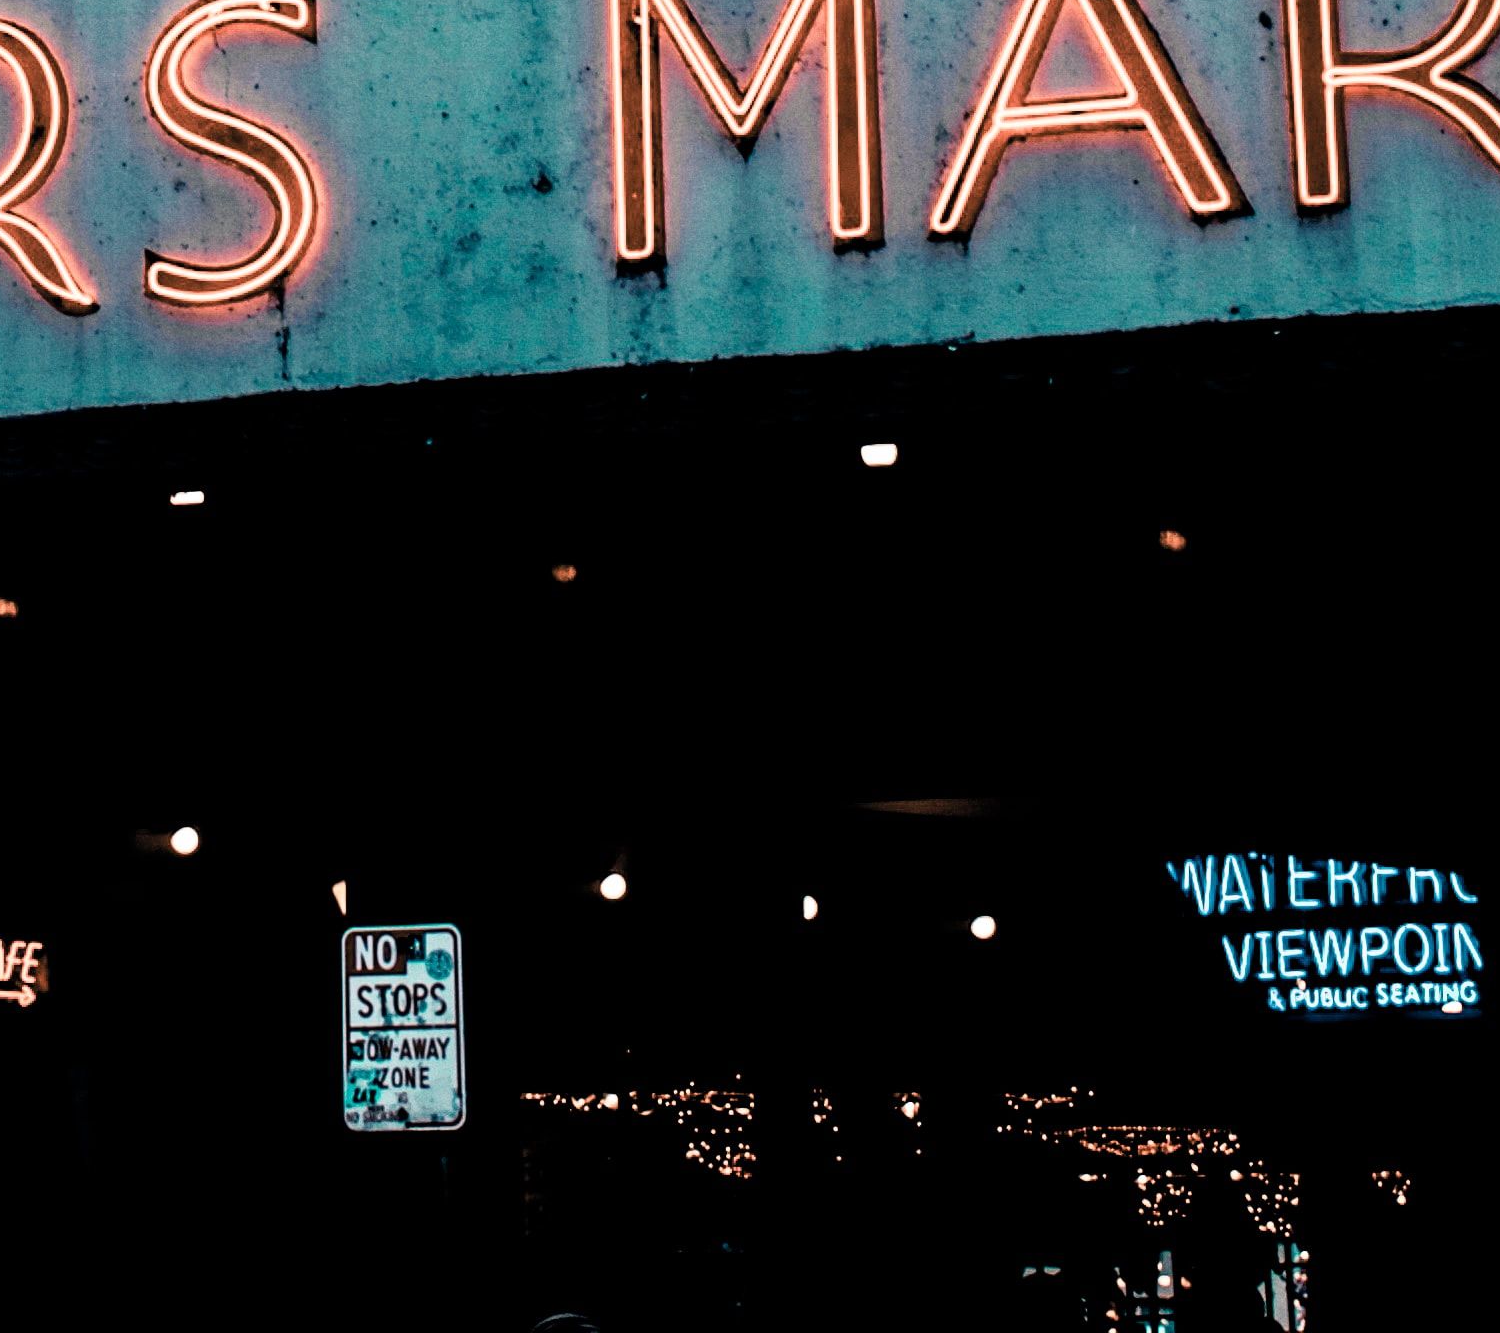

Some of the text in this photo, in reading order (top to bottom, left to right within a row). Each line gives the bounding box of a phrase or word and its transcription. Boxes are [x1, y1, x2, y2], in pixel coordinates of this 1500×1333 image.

[355, 934, 398, 971] NO
[357, 983, 448, 1018] STOPS
[1267, 981, 1478, 1011] & PUBLIC SEATING
[377, 1066, 431, 1090] ZONE
